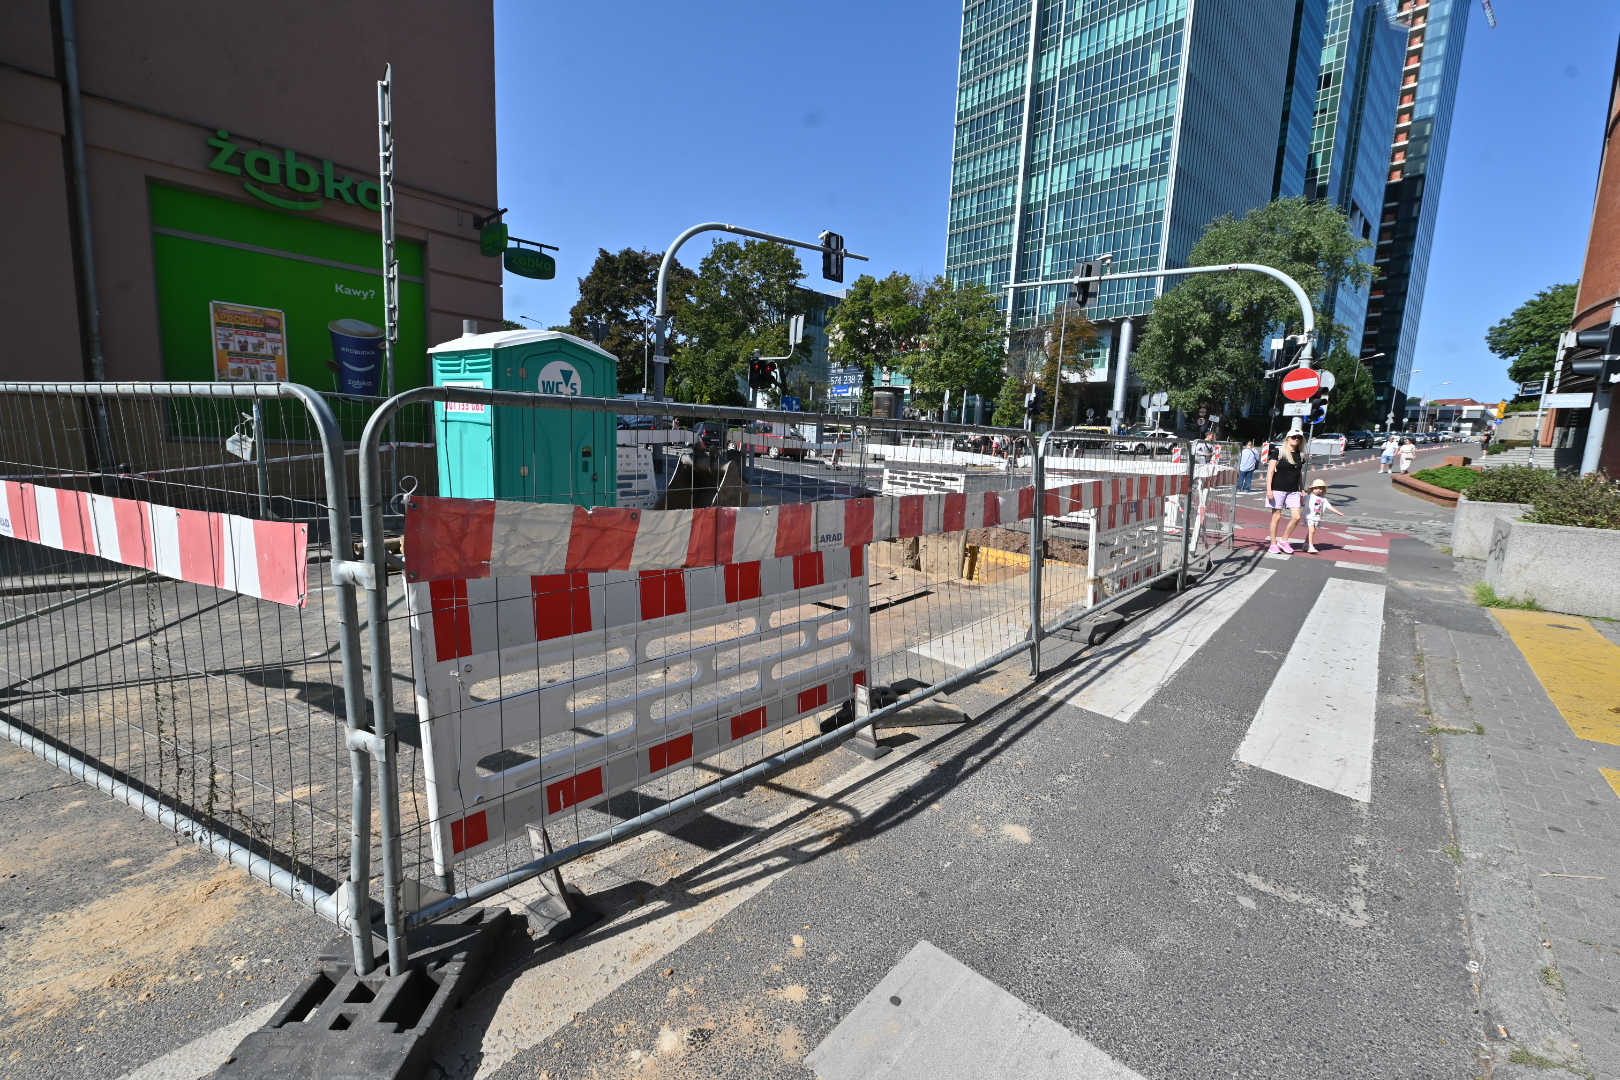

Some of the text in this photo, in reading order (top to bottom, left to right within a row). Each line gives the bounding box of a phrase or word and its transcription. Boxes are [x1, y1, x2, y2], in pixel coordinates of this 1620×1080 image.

[511, 253, 552, 271] żabka
[334, 283, 376, 300] Kawy?
[341, 346, 376, 355] #POBUDKA
[347, 378, 372, 388] żabka
[820, 533, 843, 543] ARAD
